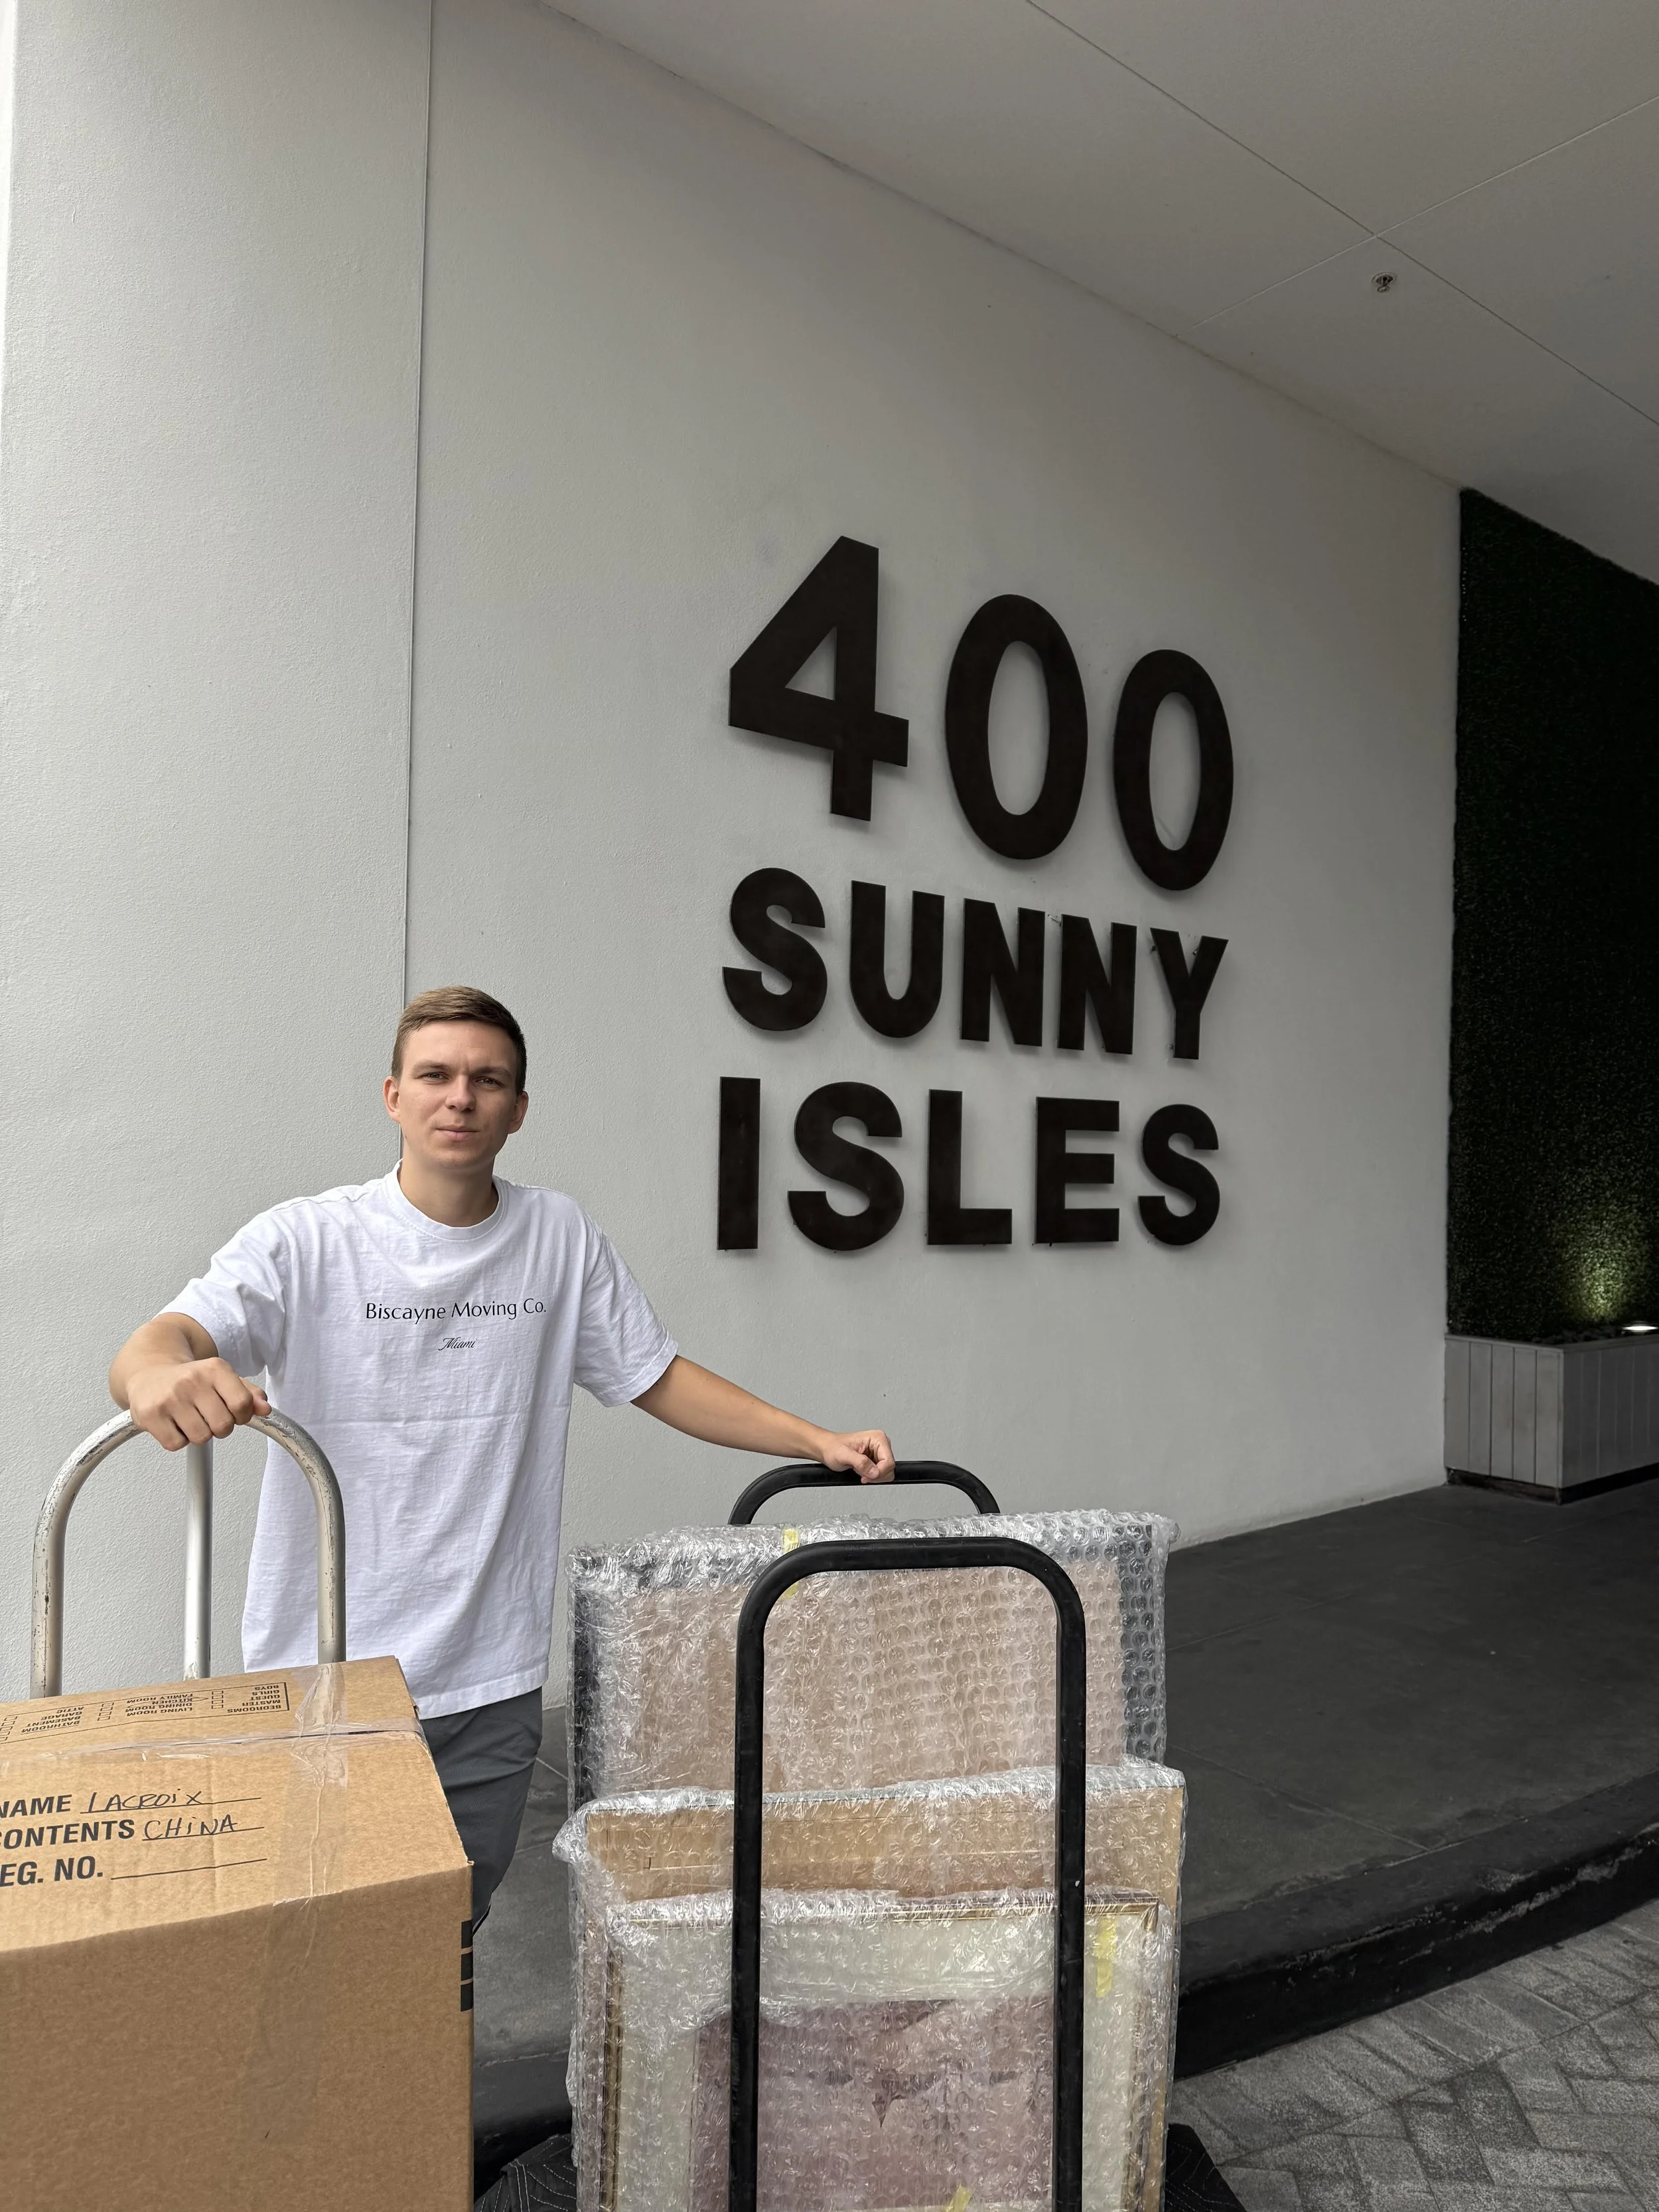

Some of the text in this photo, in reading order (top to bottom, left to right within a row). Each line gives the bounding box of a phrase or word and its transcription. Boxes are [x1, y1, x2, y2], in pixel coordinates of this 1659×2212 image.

[729, 536, 1234, 891] 400
[722, 867, 1228, 1060] SUNNY
[717, 1076, 1220, 1251] ISLES
[366, 1298, 547, 1325] Biscayne Moving Co.
[438, 1337, 477, 1351] Miami
[21, 1720, 80, 1733] BATHROOM
[25, 1716, 81, 1728] BASEMENT
[40, 1711, 83, 1720] GARAGE
[0, 1819, 134, 1850] ONTENTS
[54, 1856, 104, 1882] NO.
